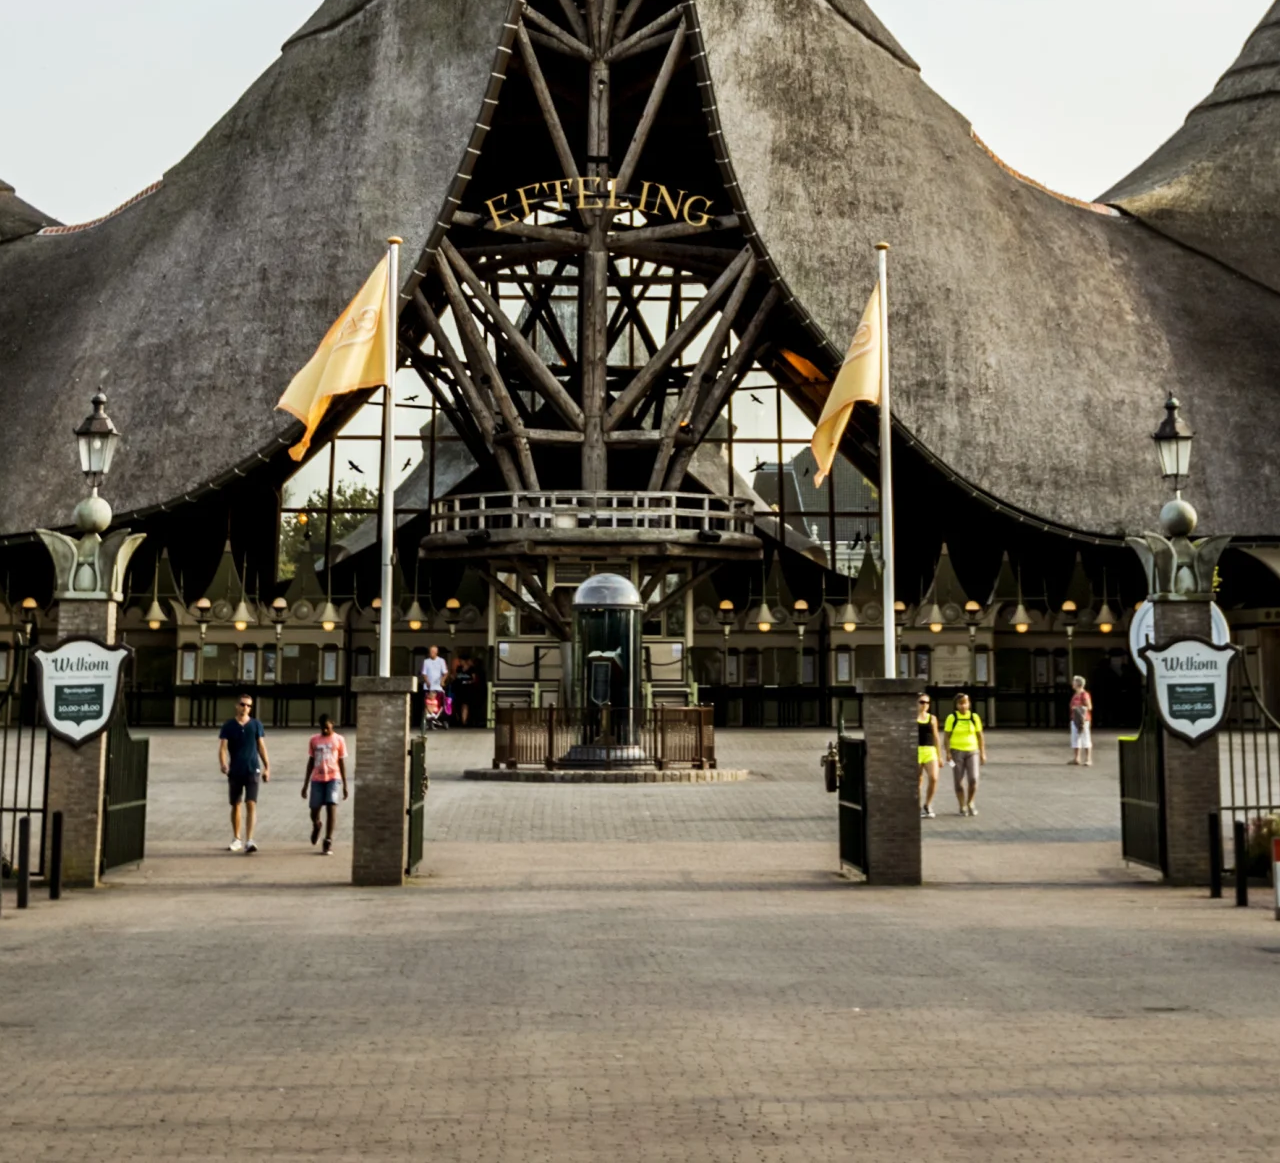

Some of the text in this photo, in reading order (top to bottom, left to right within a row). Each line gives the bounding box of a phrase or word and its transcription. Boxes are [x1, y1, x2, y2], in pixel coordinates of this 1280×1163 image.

[484, 176, 715, 231] EFTELING
[51, 656, 109, 673] Welkom
[1161, 656, 1218, 672] Welkom
[58, 703, 100, 712] 10.00-18.00
